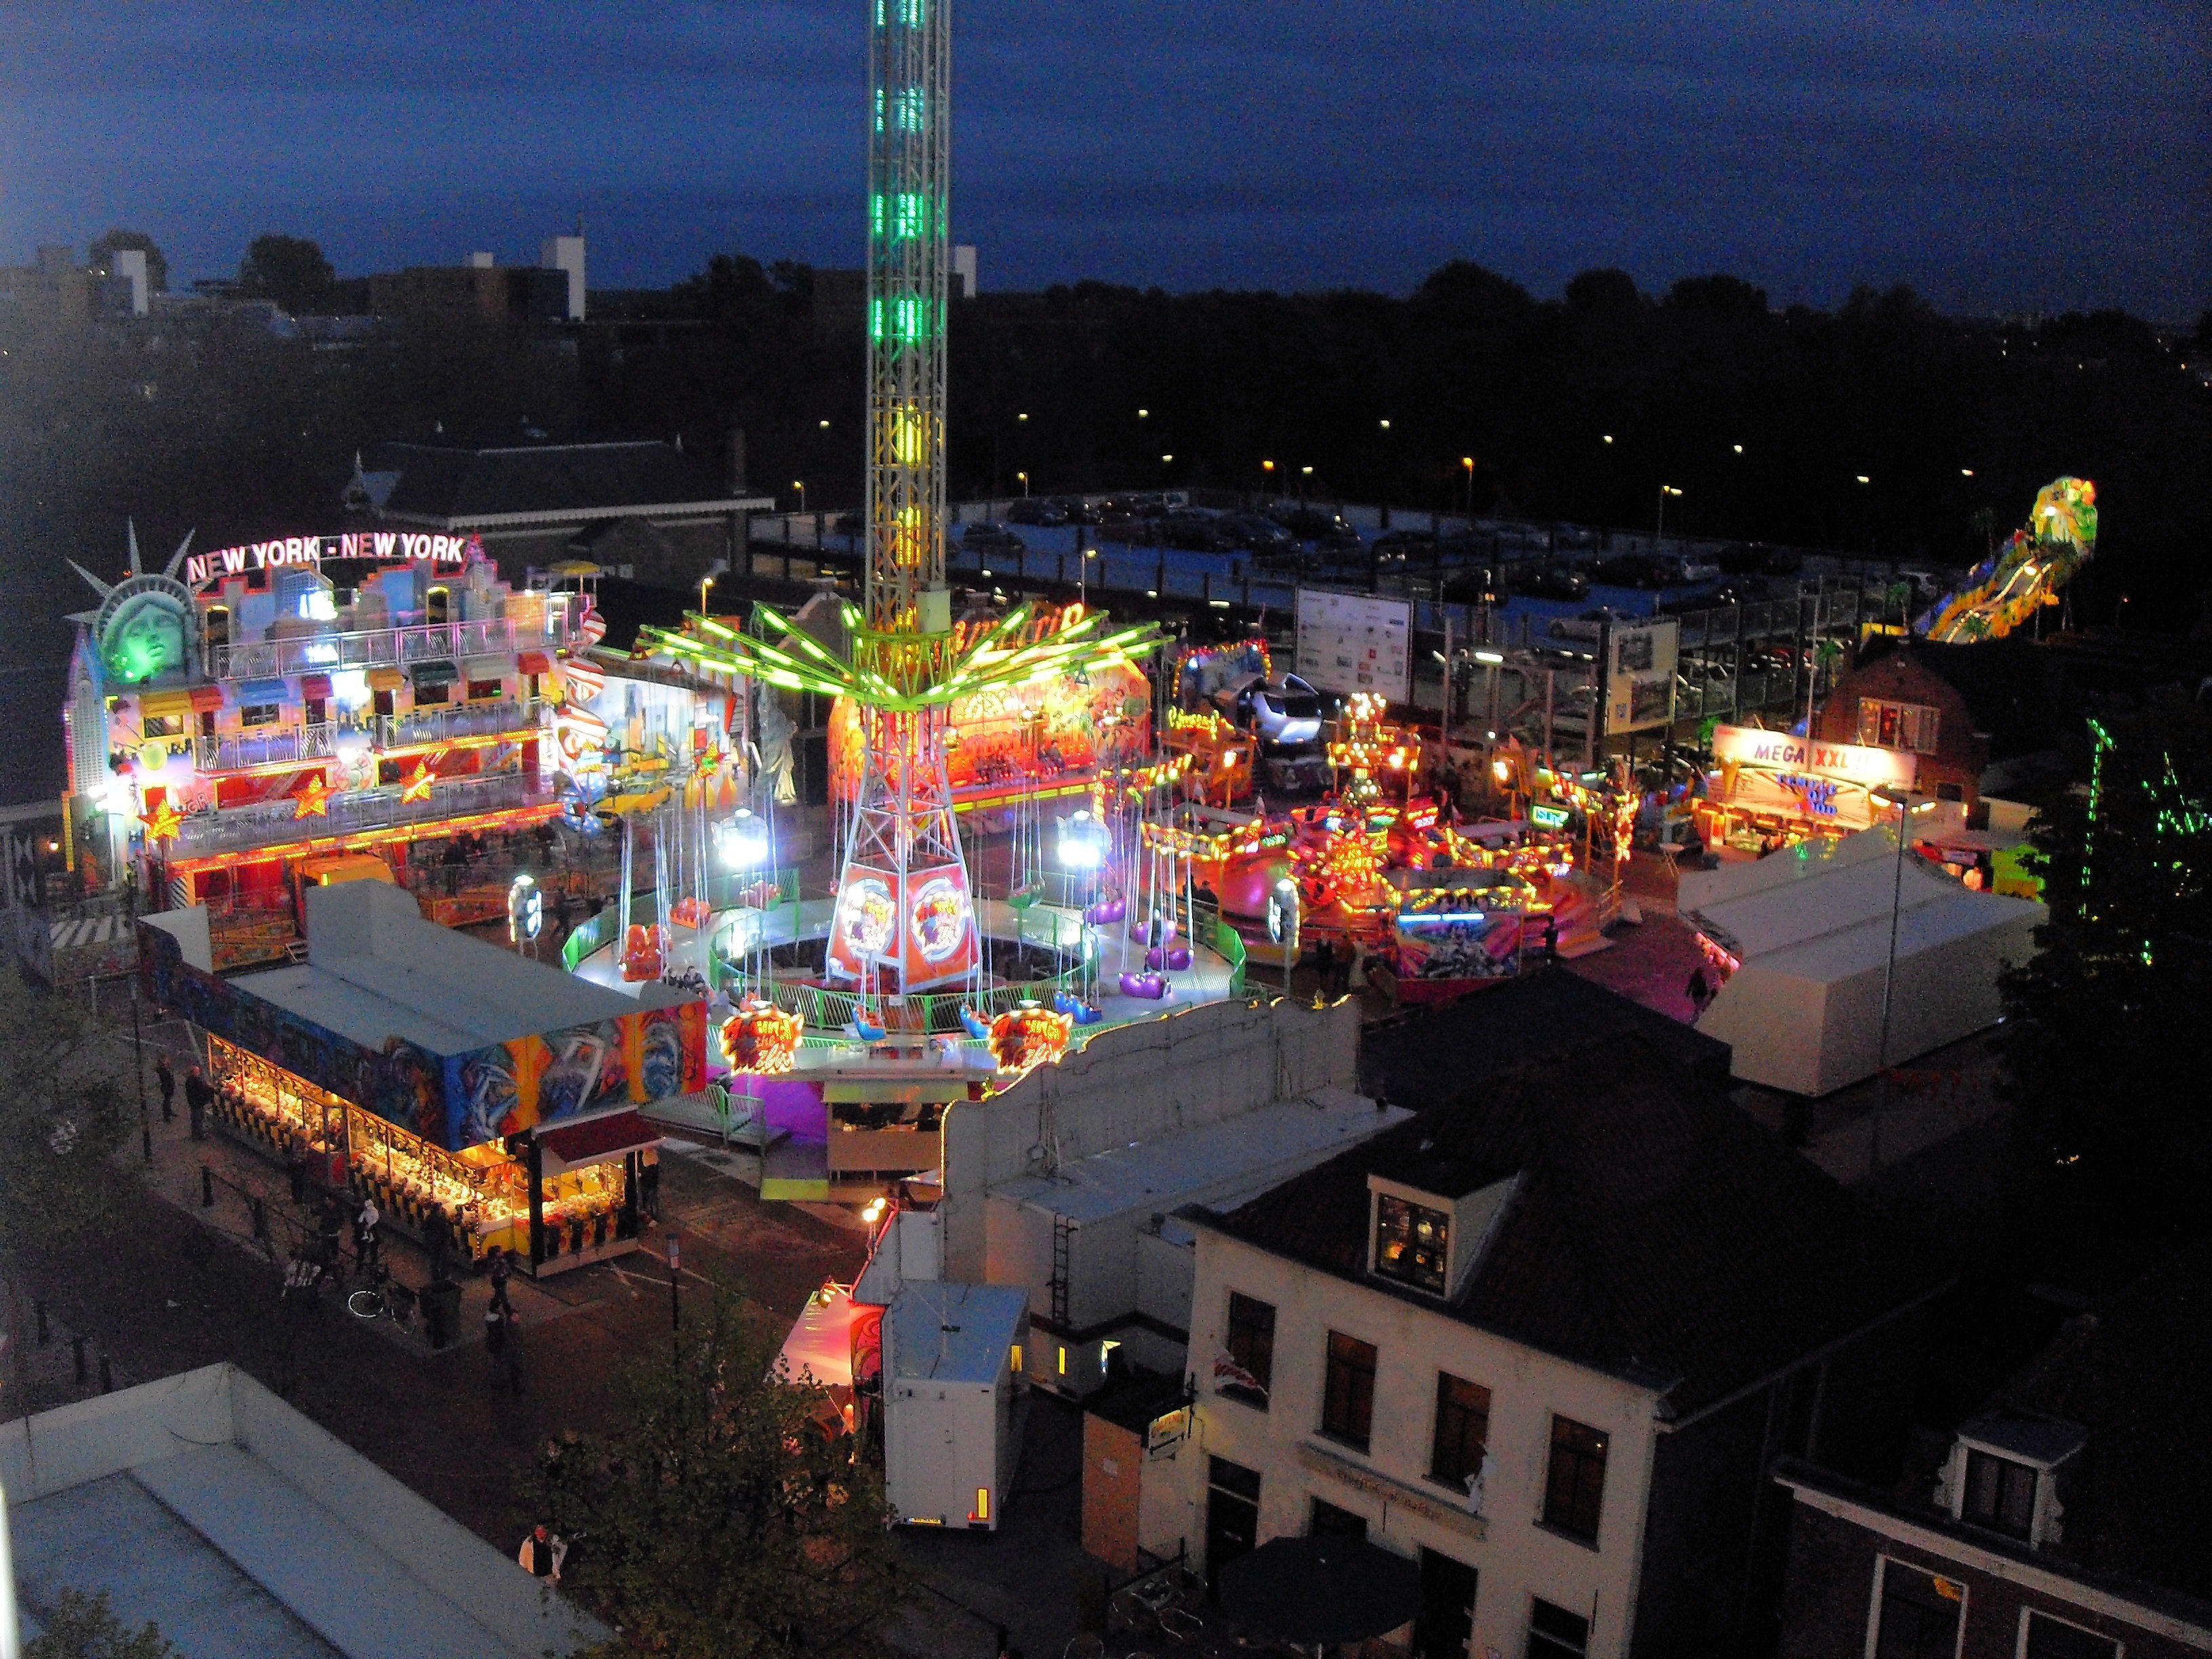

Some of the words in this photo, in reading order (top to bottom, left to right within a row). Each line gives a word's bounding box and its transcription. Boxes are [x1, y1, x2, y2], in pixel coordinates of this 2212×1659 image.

[187, 546, 247, 583] NEW
[251, 535, 320, 569] YORK
[341, 532, 397, 558] NEW
[401, 532, 466, 562] YORK
[1754, 744, 1806, 764] MEGA
[1815, 747, 1849, 769] XXL
